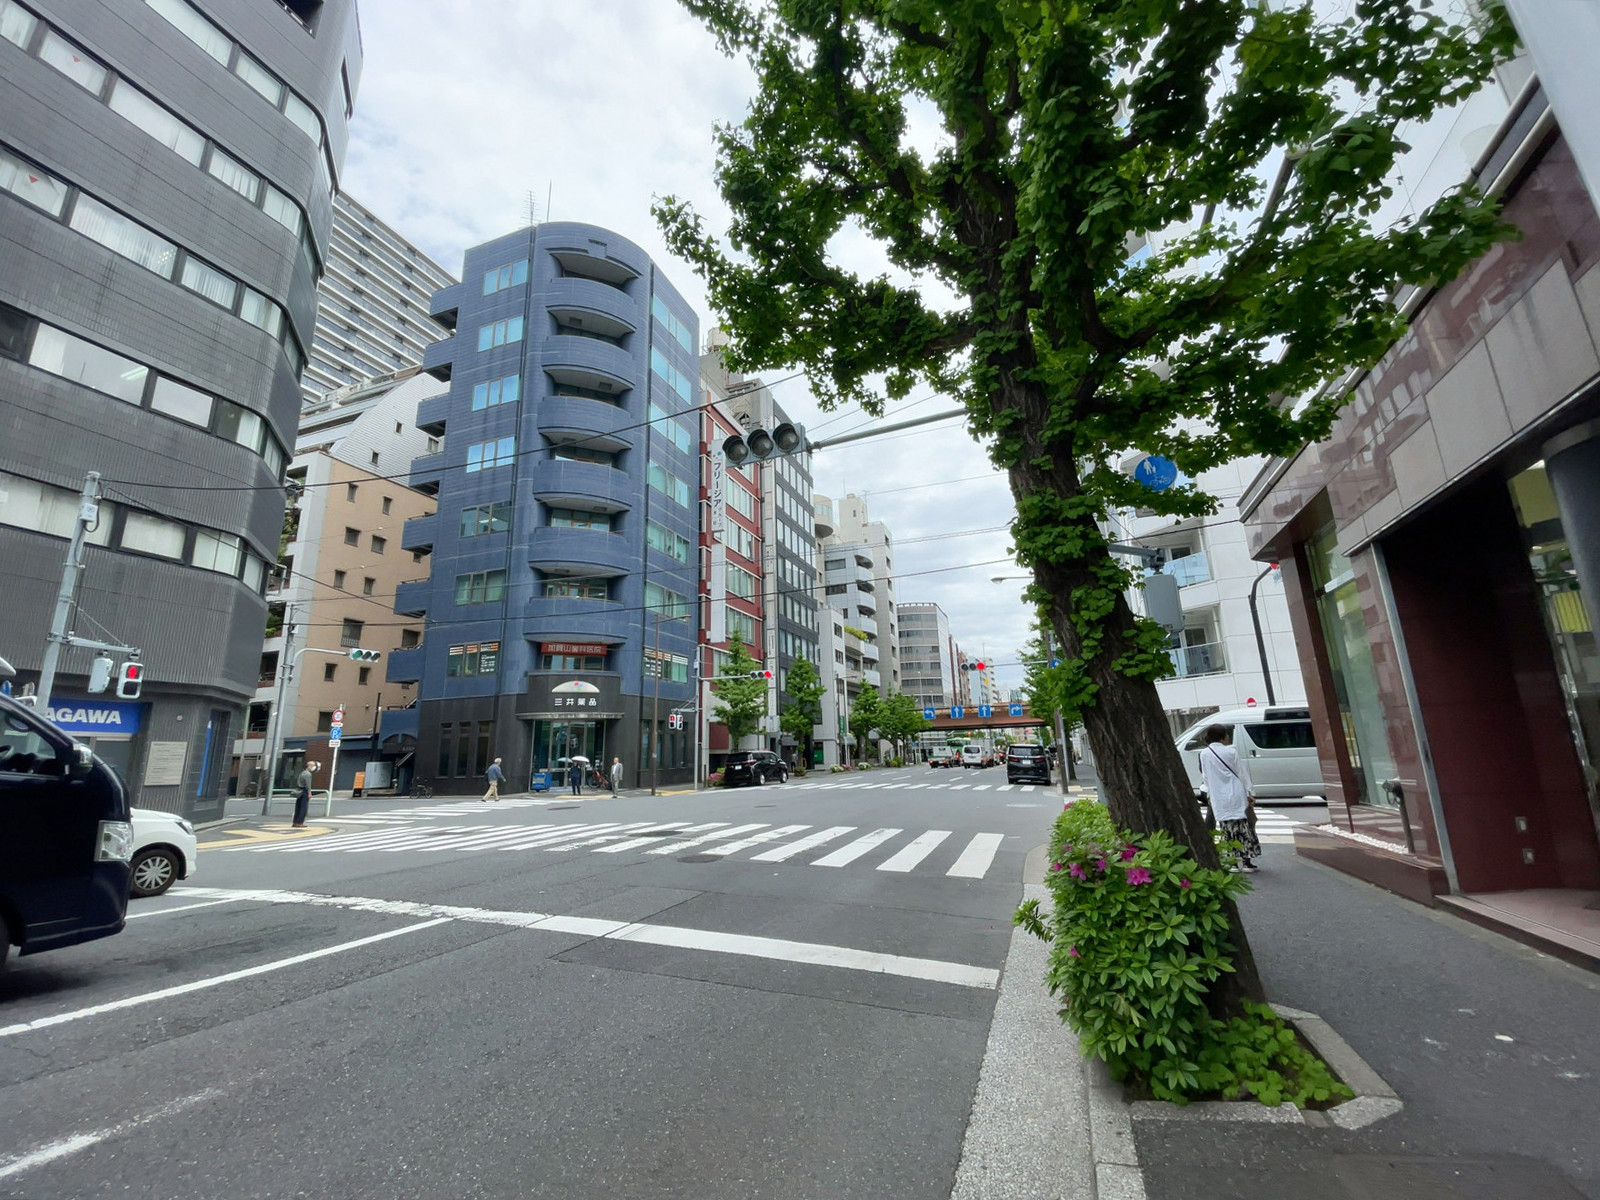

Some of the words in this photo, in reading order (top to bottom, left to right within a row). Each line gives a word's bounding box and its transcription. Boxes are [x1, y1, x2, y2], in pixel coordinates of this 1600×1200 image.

[713, 462, 722, 508] フリージア
[554, 697, 597, 707] 三井薬品
[45, 707, 122, 725] AGAWA
